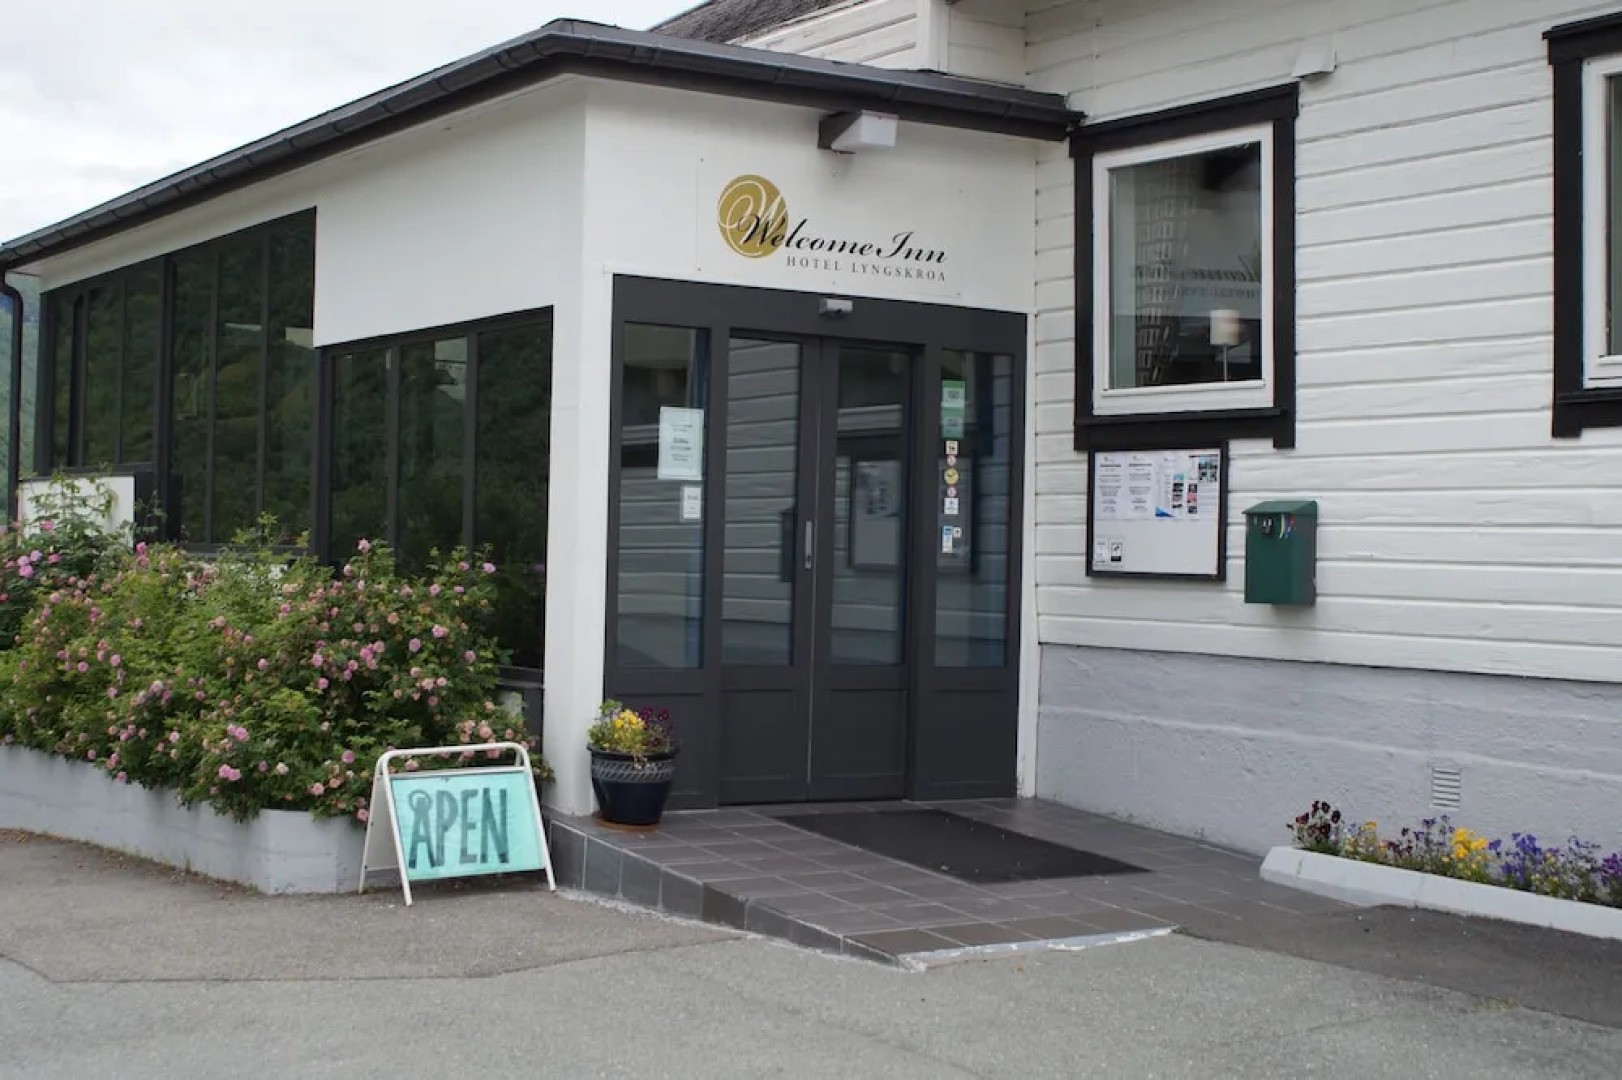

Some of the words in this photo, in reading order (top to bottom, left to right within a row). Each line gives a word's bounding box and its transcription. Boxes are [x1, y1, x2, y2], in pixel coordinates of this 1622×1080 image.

[738, 213, 873, 257] Welcome
[876, 230, 947, 264] Inn
[786, 255, 842, 272] HOTEL
[851, 261, 945, 282] LYNGSKROA
[407, 787, 510, 870] ÅPEN
